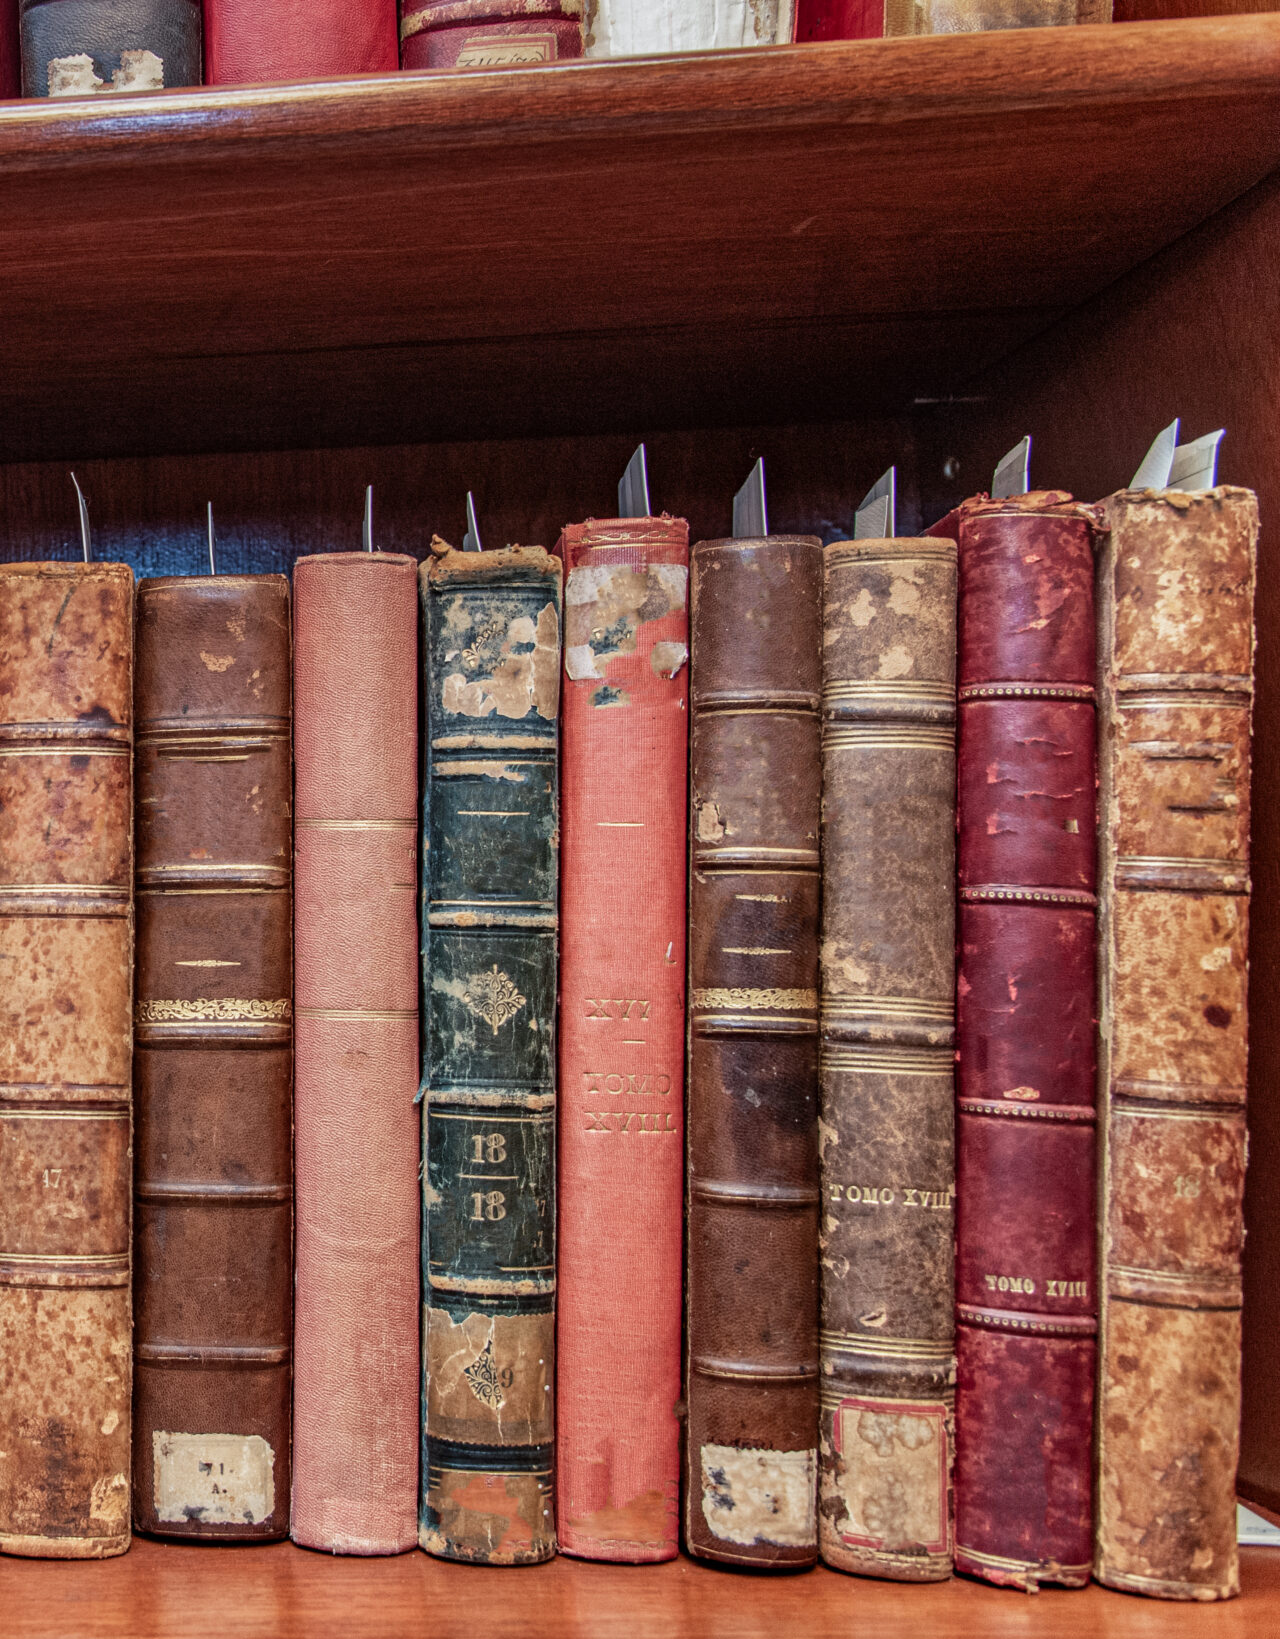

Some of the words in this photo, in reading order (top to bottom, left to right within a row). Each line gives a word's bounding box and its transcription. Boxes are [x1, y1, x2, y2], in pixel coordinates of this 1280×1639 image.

[471, 1133, 507, 1163] 18
[471, 1190, 507, 1221] 18
[829, 1183, 895, 1205] TOMO
[902, 1188, 952, 1209] XVIII
[984, 1274, 1035, 1295] TOMO
[1045, 1280, 1088, 1297] XVIII
